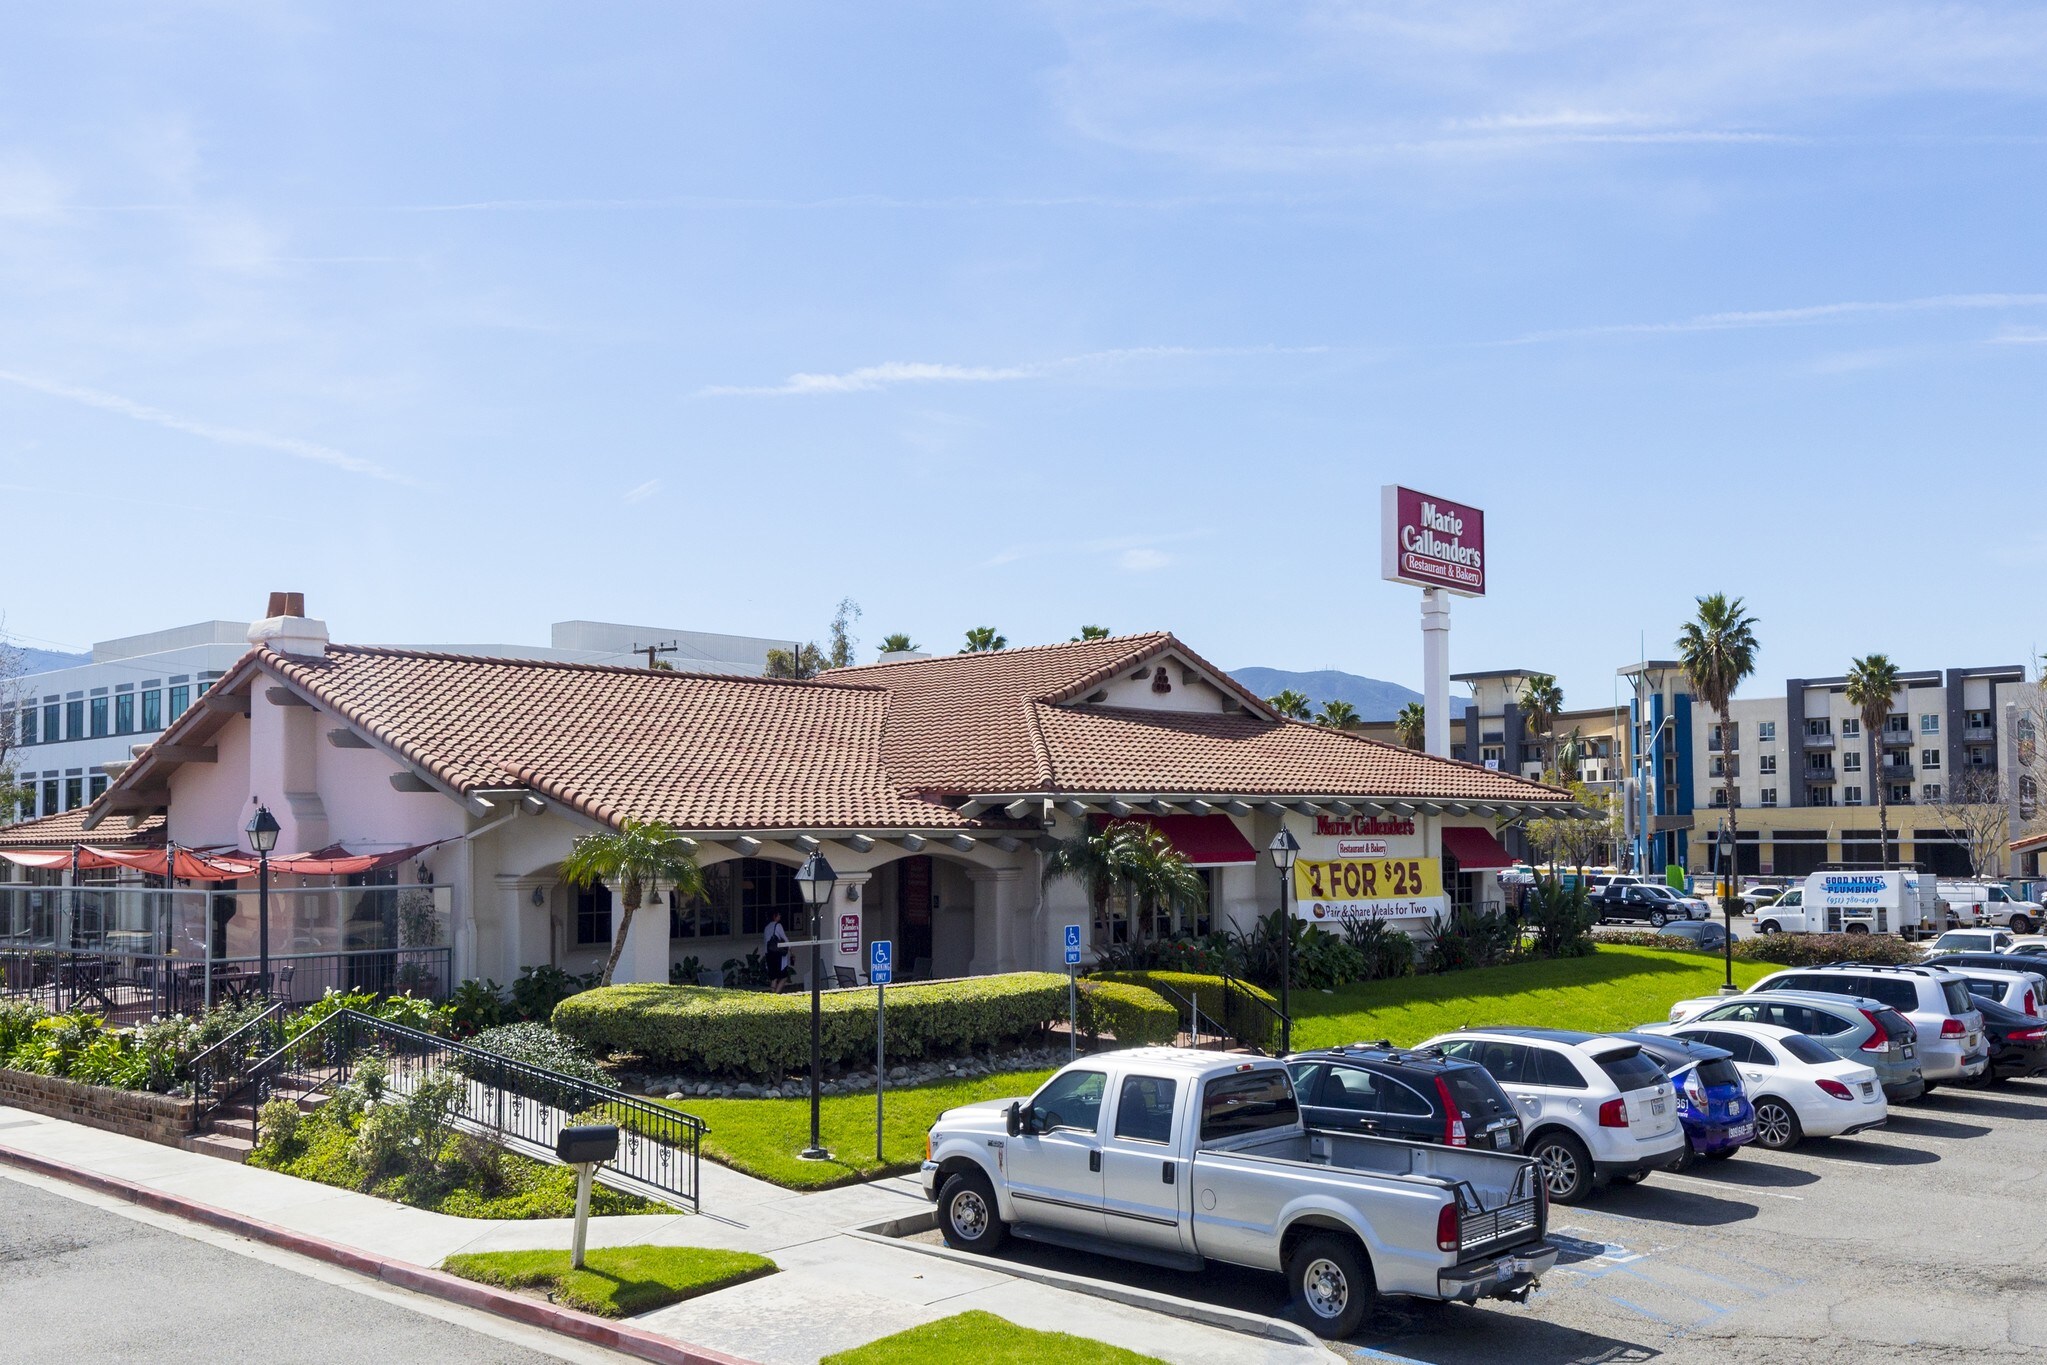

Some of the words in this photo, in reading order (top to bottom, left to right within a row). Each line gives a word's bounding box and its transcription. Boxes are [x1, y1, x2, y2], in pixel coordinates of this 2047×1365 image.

[1420, 501, 1463, 536] Marie
[1401, 525, 1481, 568] Callender's
[1408, 555, 1447, 576] Restaurant
[1448, 564, 1455, 578] &
[1456, 567, 1479, 585] Bakery
[1315, 815, 1352, 836] Marie
[1340, 843, 1365, 854] Restaurant
[1366, 843, 1370, 853] &
[1371, 844, 1387, 855] Bakery
[1310, 864, 1324, 897] 2
[1329, 862, 1377, 897] FOR
[1385, 861, 1422, 895] $25
[1826, 876, 1848, 884] GOOD
[1852, 875, 1880, 884] NEWS
[1828, 885, 1878, 893] PLUMBING
[1326, 904, 1341, 917] Pair
[1342, 904, 1349, 918] &
[1350, 904, 1370, 918] Share
[1372, 903, 1394, 917] Meals
[1396, 902, 1407, 915] for
[1409, 901, 1427, 914] Two
[872, 963, 890, 971] PARKING
[875, 973, 887, 981] ONLY
